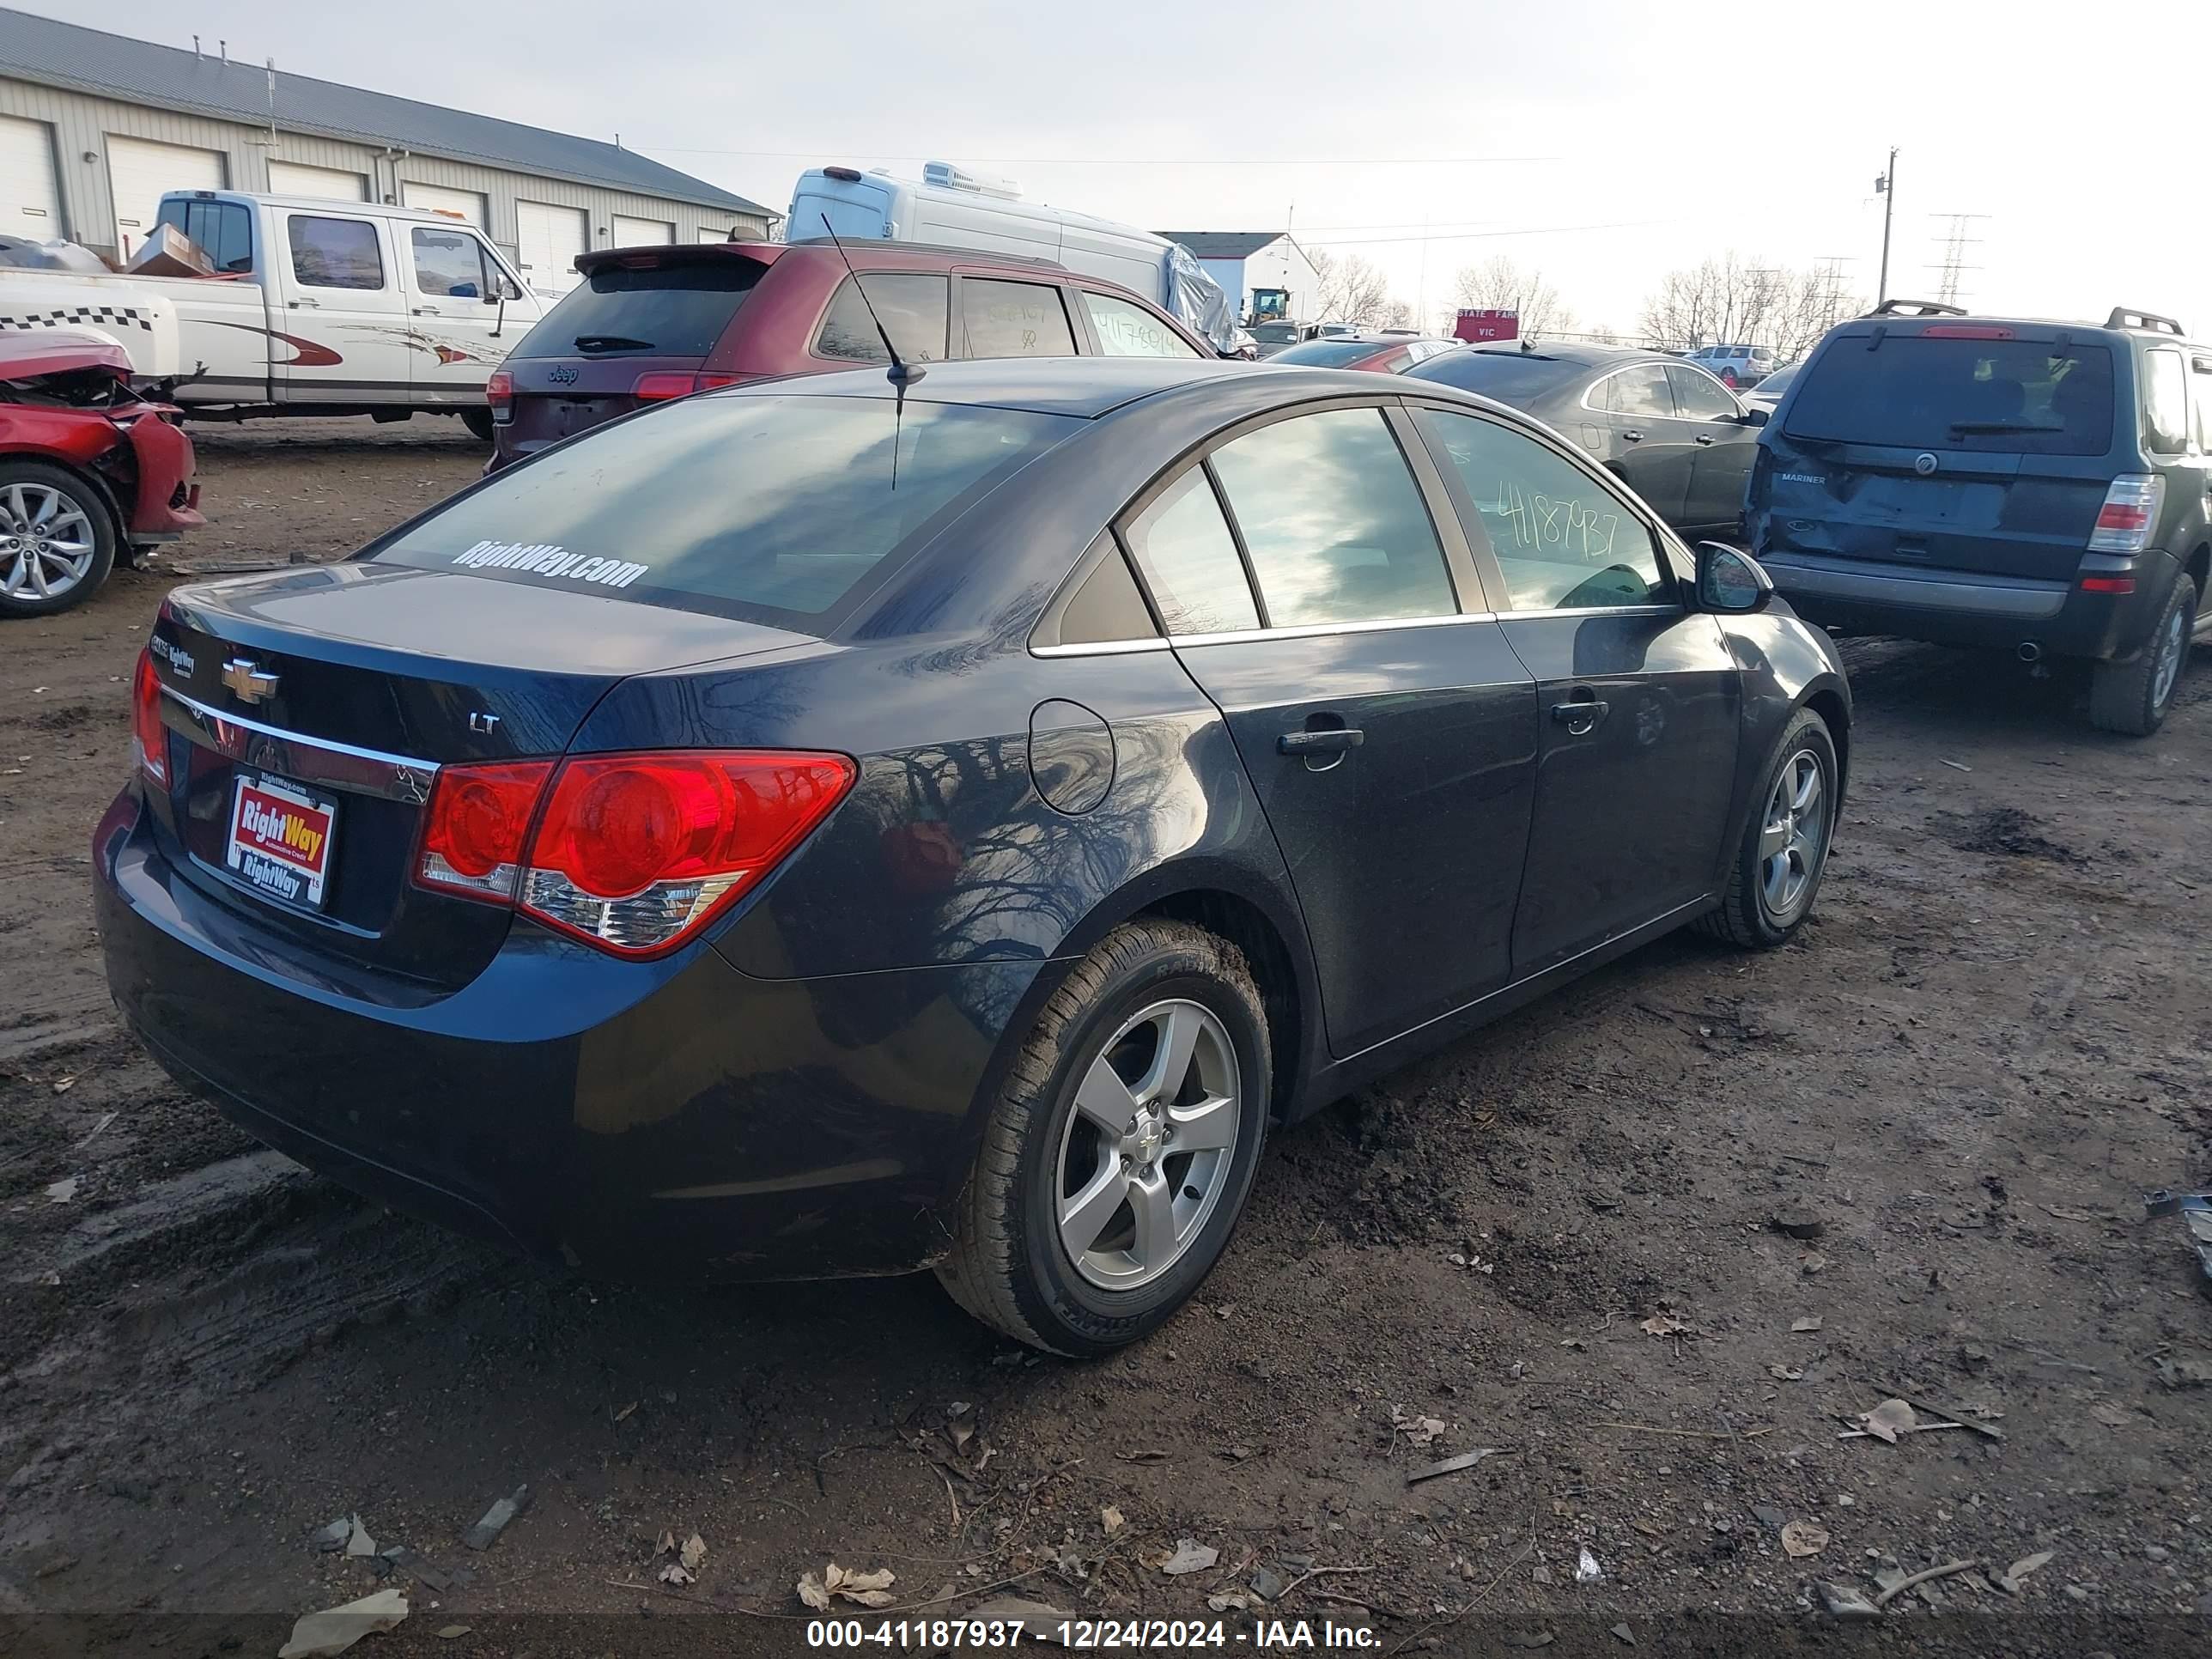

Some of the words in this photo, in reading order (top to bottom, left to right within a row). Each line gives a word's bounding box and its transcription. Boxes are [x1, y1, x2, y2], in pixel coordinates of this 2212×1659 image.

[1479, 328, 1495, 337] VIC
[549, 365, 578, 386] Jeep
[1782, 473, 1826, 484] MARINER
[1498, 480, 1619, 562] 41187937
[451, 539, 649, 588] RightWay.com
[470, 712, 501, 736] LT
[241, 799, 323, 862] RightWay
[242, 855, 301, 900] RightWay
